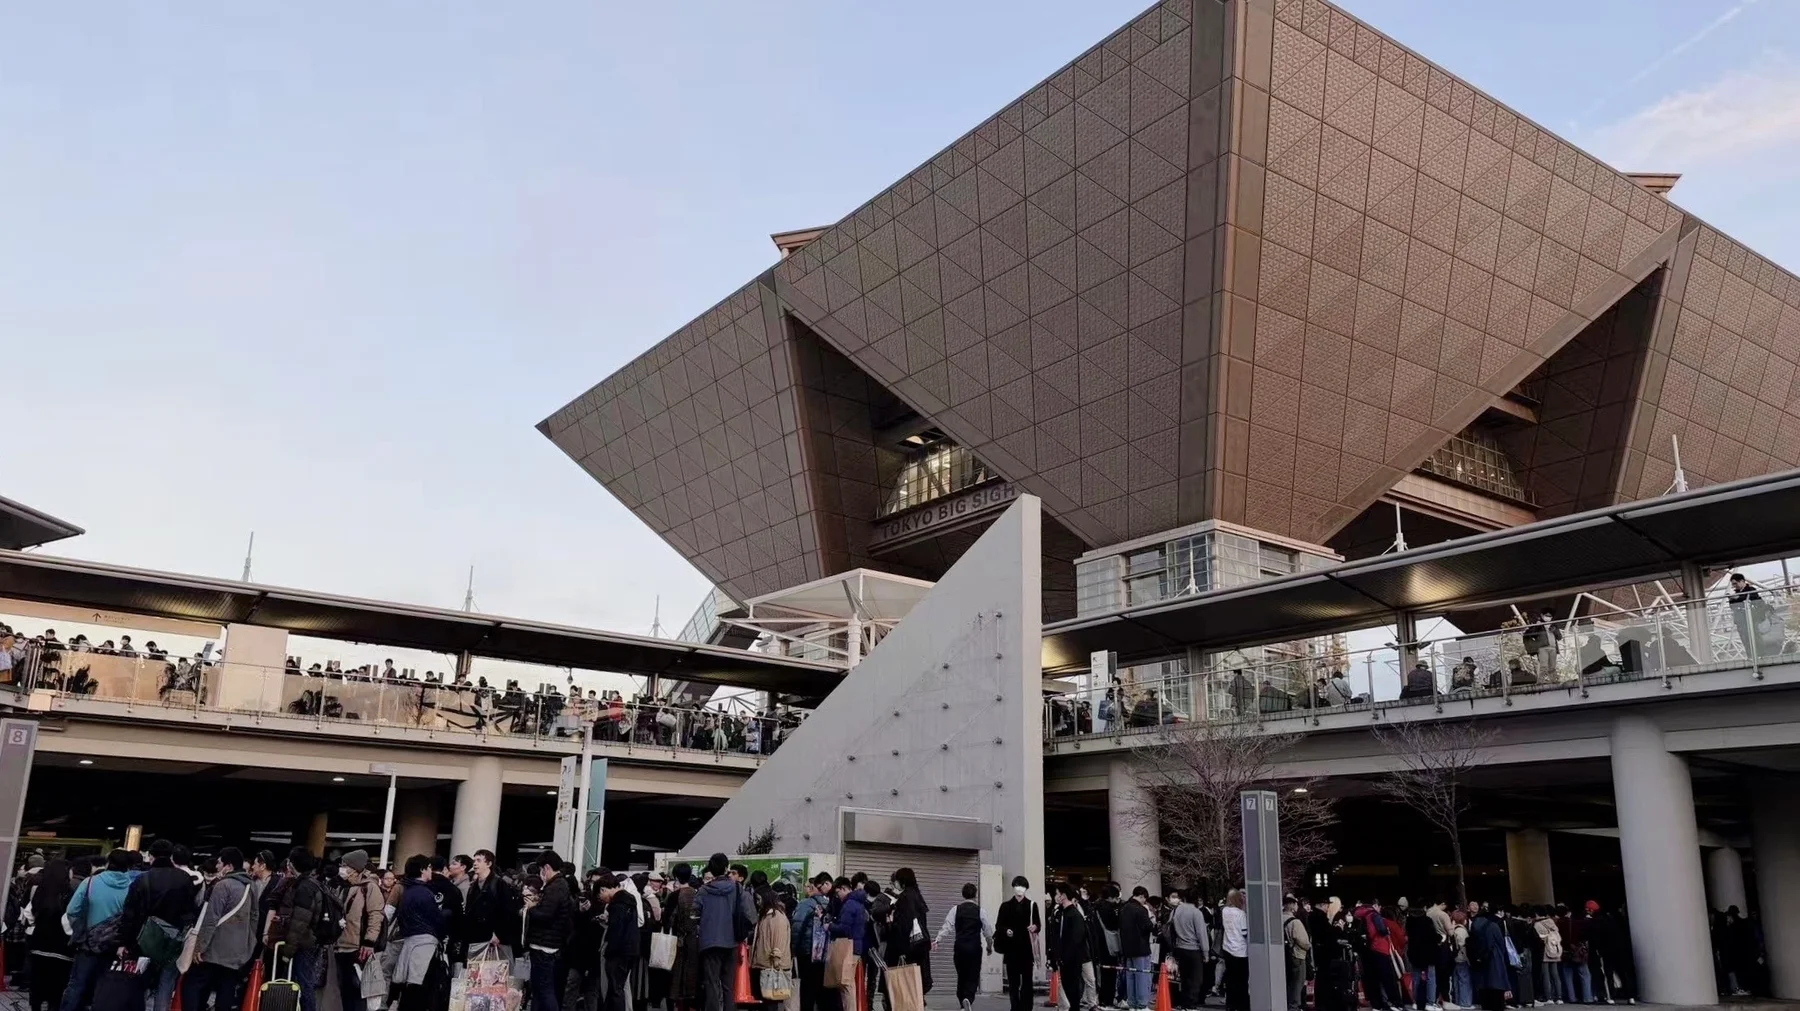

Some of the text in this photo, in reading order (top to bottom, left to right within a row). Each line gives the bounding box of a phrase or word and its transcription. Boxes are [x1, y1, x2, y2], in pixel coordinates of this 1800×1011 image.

[882, 511, 932, 539] TOKYO
[939, 500, 966, 520] BIG
[13, 731, 22, 742] 8
